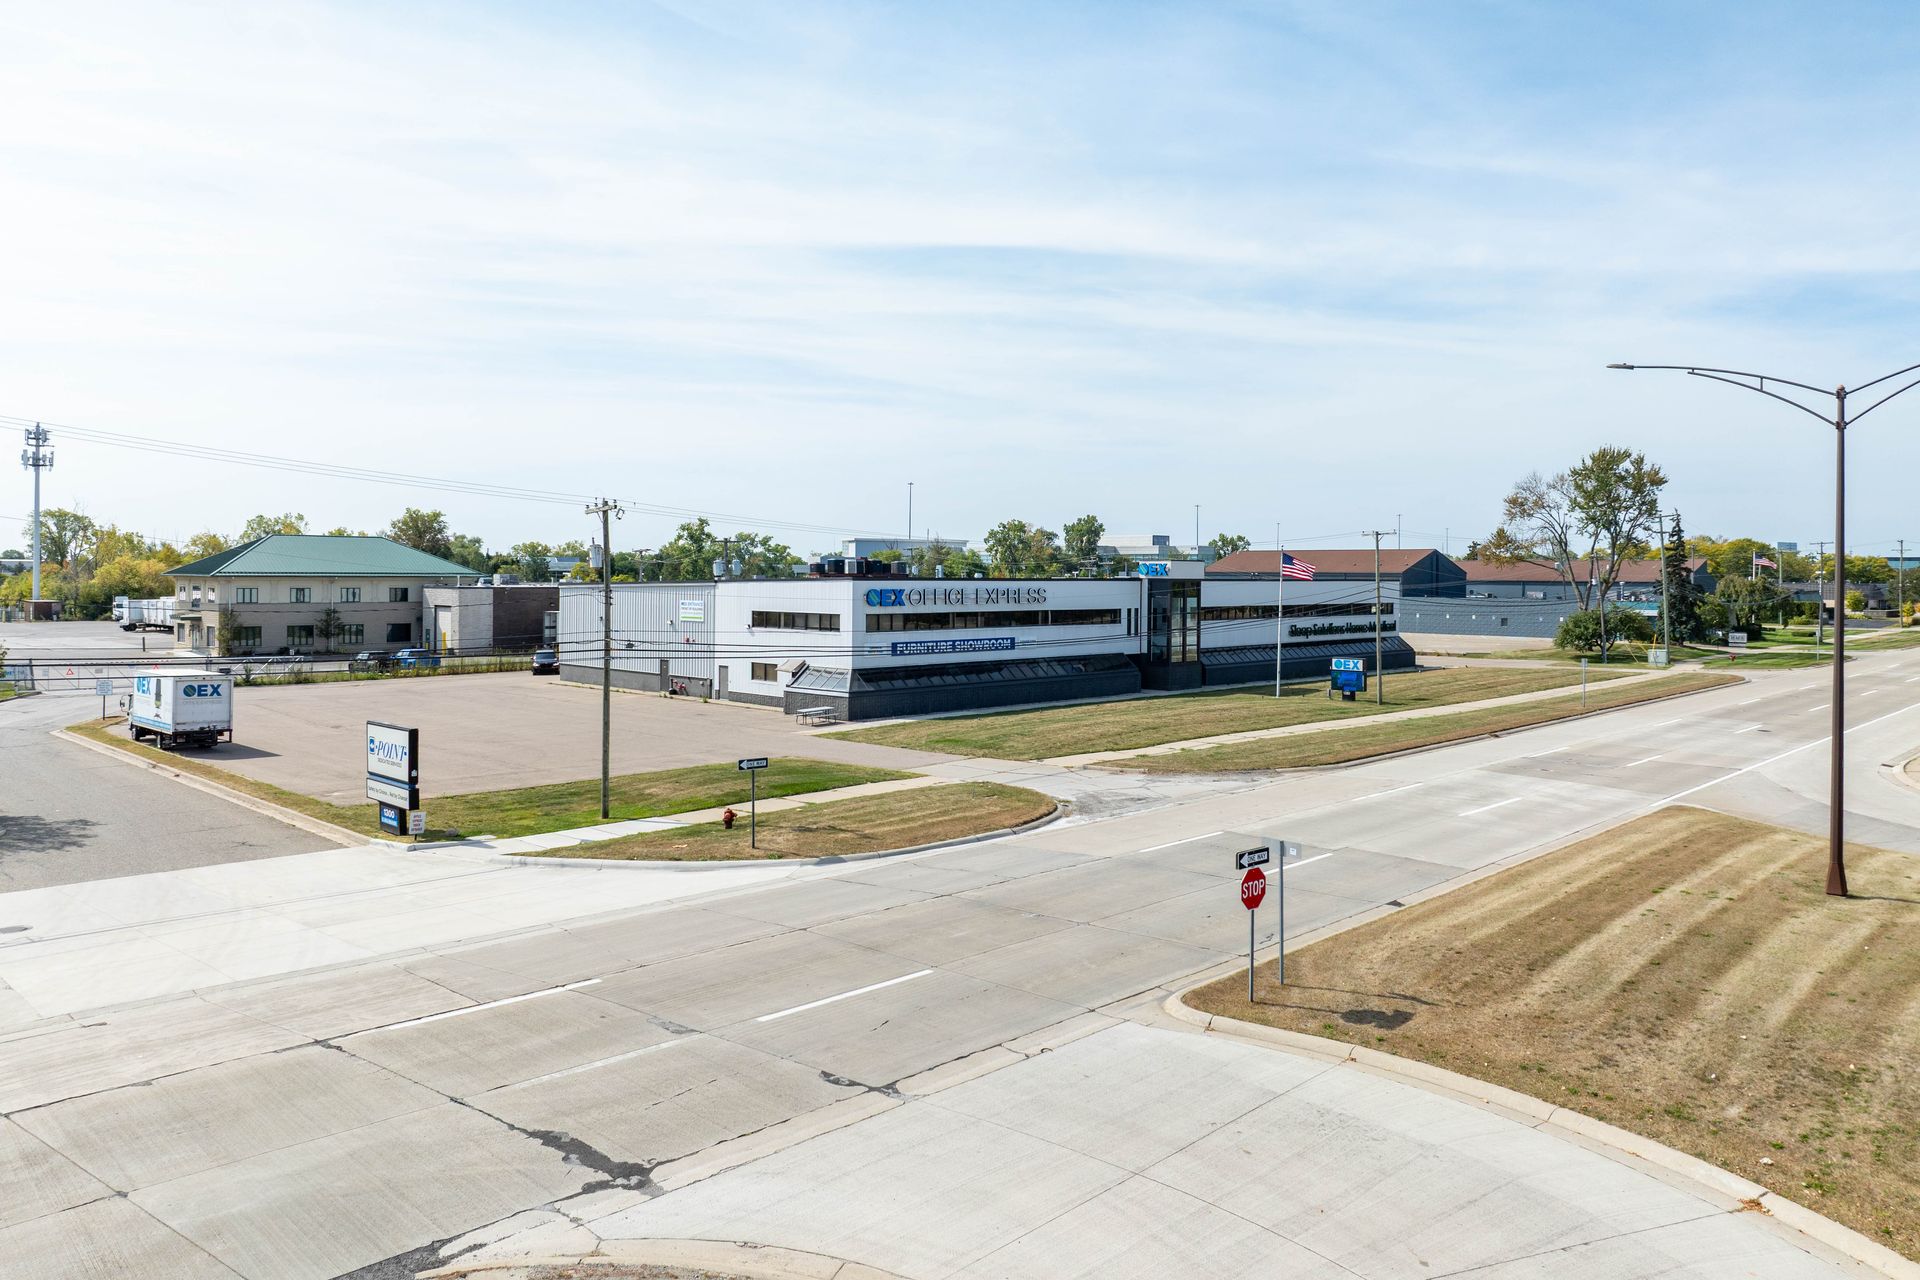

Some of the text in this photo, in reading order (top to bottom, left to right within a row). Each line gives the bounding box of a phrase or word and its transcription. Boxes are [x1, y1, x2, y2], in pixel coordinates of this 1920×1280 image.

[1138, 563, 1168, 576] OEX
[866, 588, 1047, 607] OEX OFFICE EXPRESS
[1289, 620, 1397, 638] Sleep Solutions Home Mdical
[896, 642, 953, 654] FURNITURE
[954, 639, 1011, 652] SHOWROOM
[1334, 660, 1360, 670] OEX
[136, 676, 152, 695] OEX
[183, 684, 222, 697] OEX
[1247, 852, 1267, 862] ONE WAY
[1242, 879, 1265, 898] STOP
